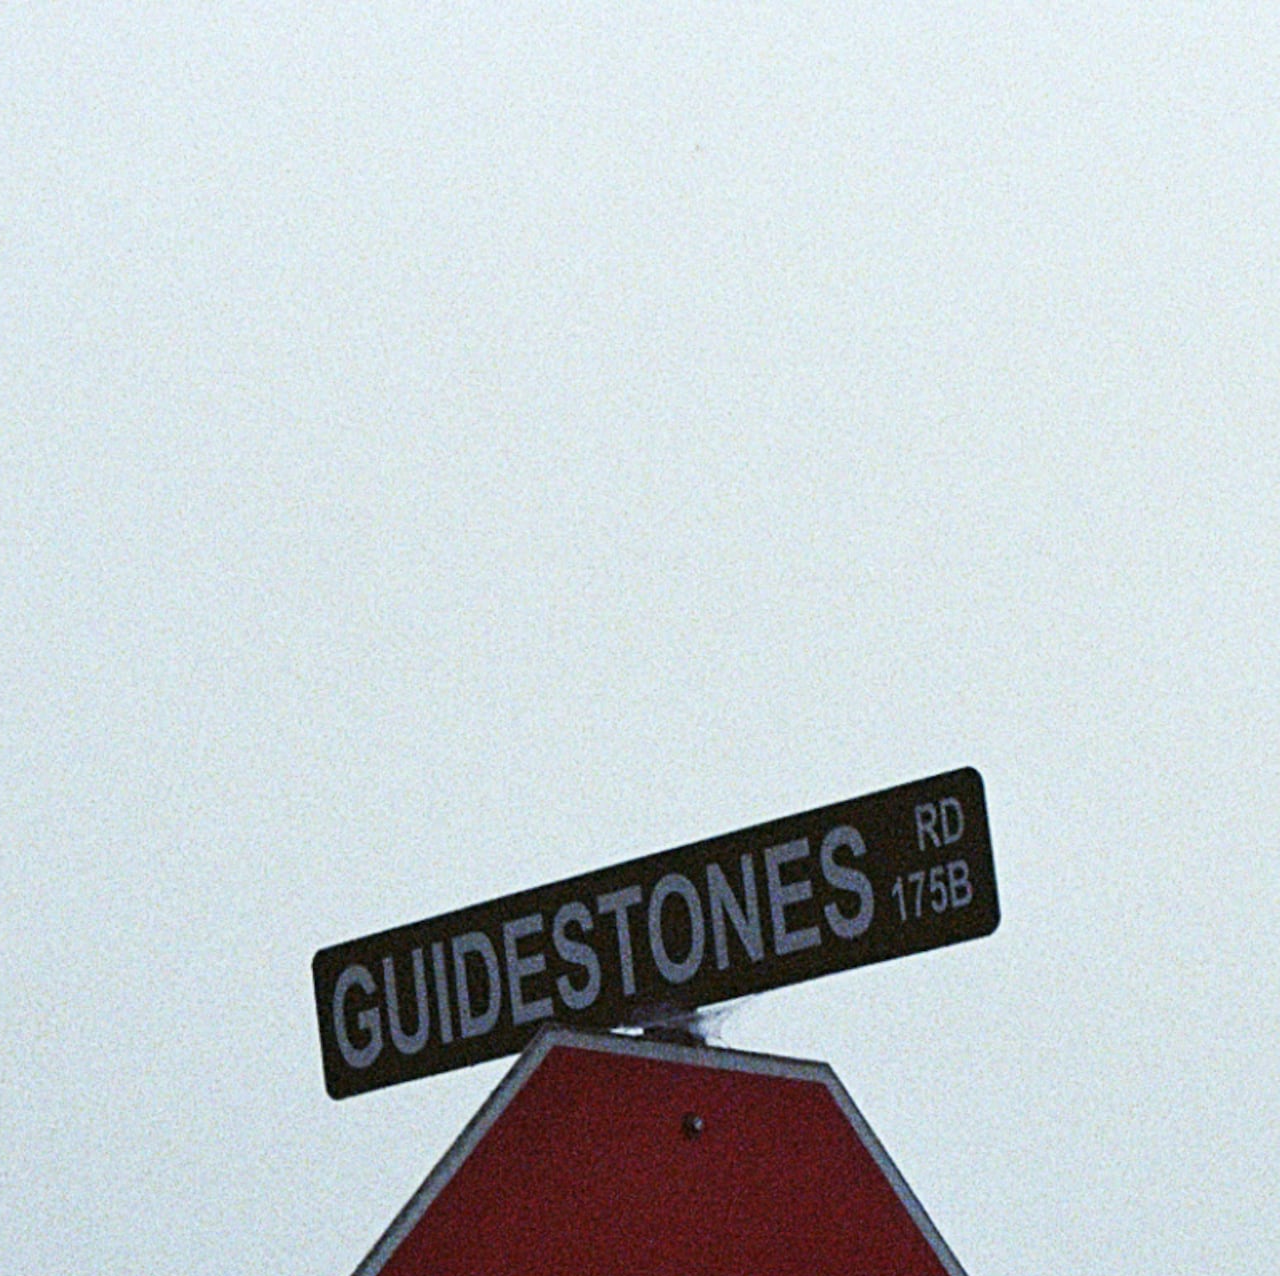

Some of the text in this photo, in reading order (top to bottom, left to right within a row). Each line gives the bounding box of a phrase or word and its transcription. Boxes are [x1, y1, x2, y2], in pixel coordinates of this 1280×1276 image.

[333, 797, 965, 1069] GUIDESTONES RD
[891, 859, 974, 921] 175B
